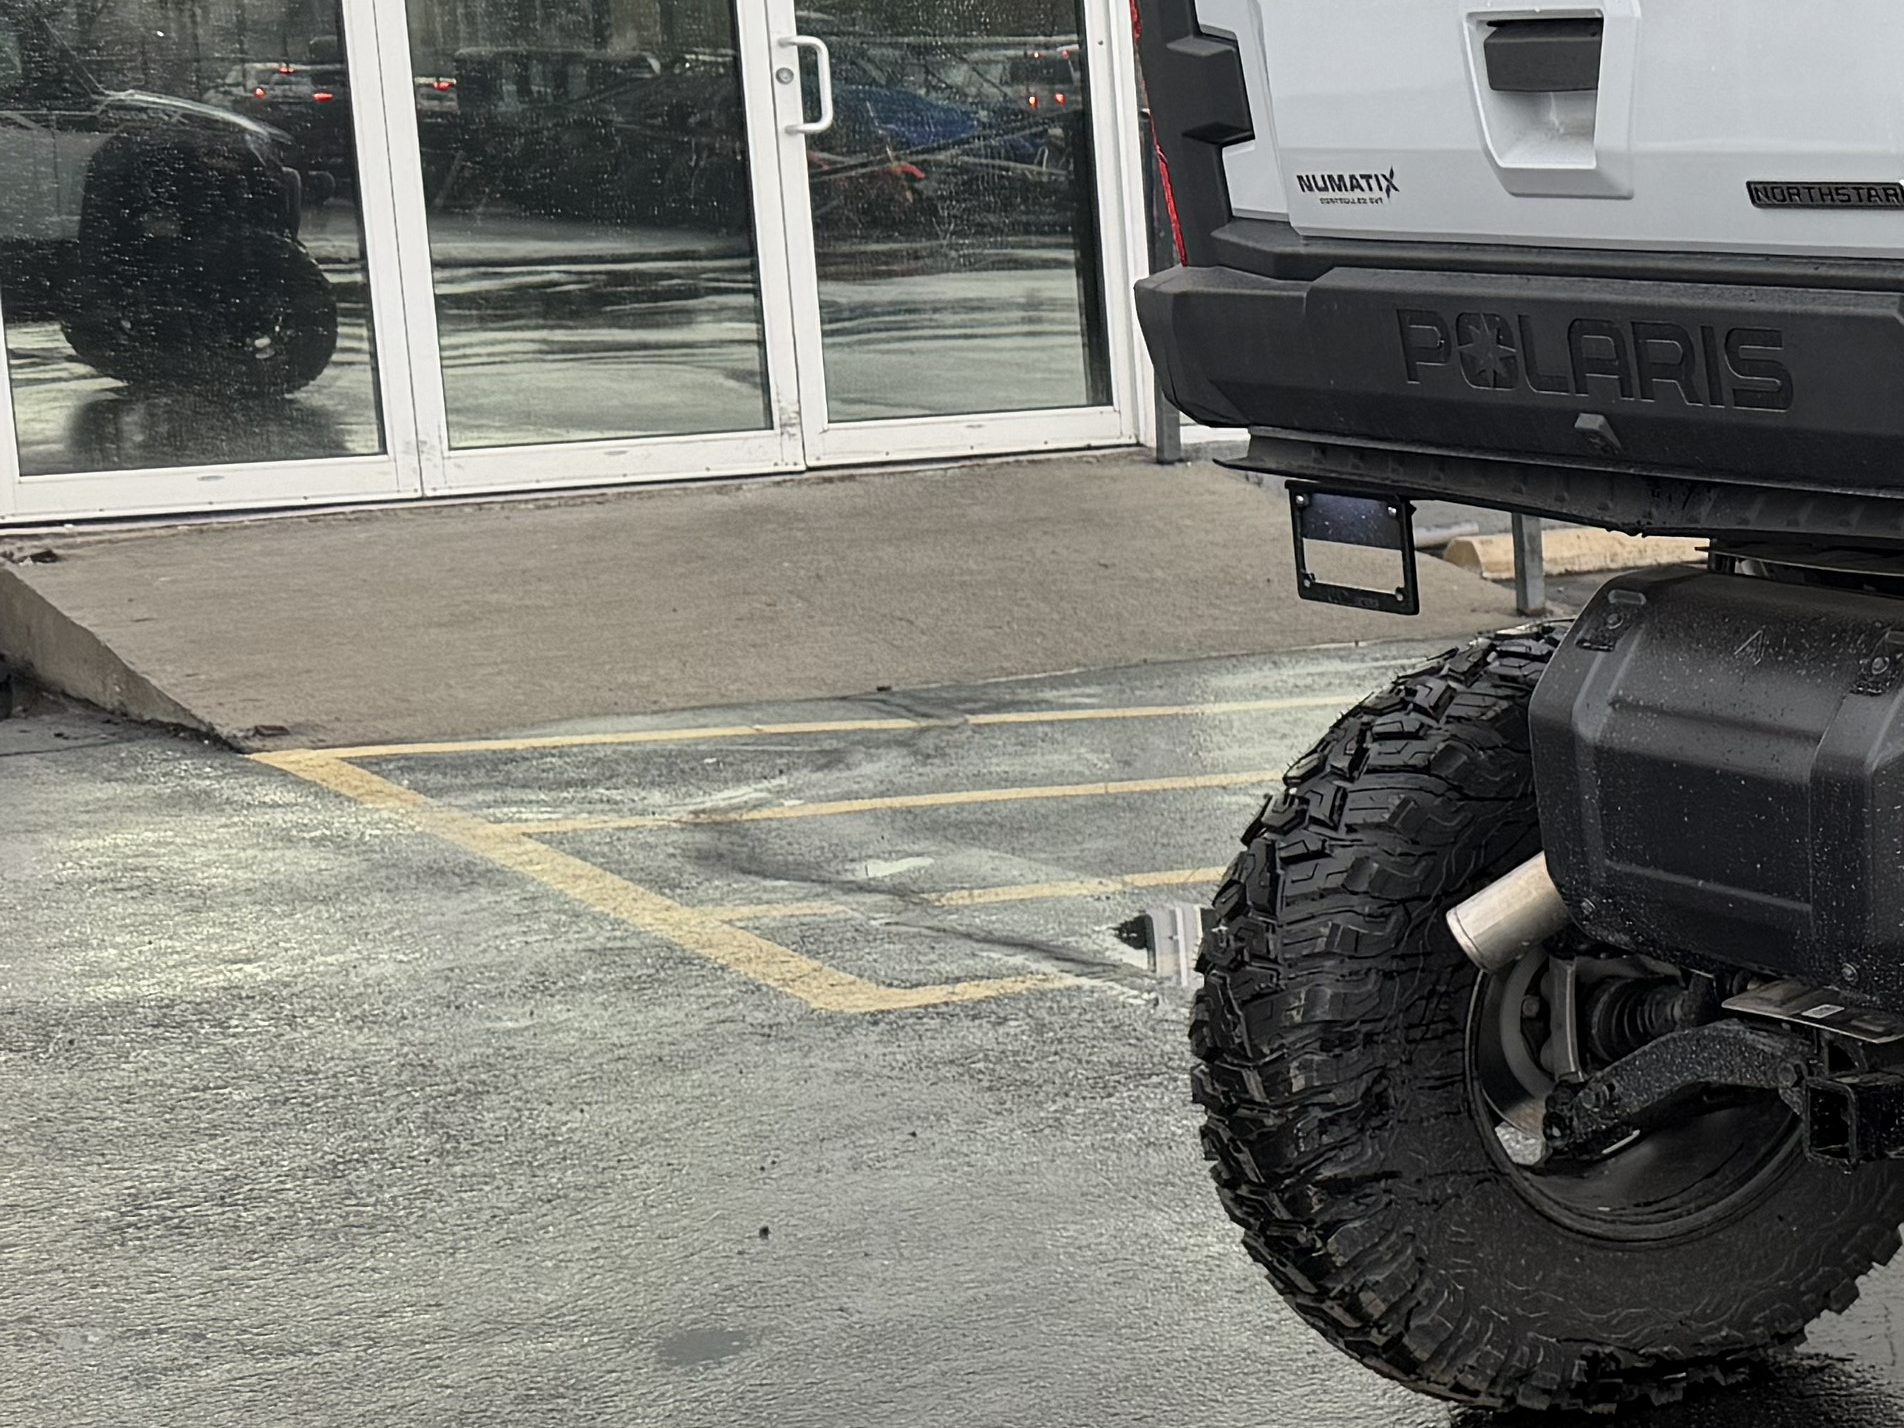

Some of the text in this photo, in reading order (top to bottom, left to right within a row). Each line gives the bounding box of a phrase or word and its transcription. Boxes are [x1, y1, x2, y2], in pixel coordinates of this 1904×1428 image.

[1296, 164, 1400, 200] NUMATIX
[1753, 185, 1901, 204] NORTHSTAR
[1396, 308, 1795, 412] POLARIS
